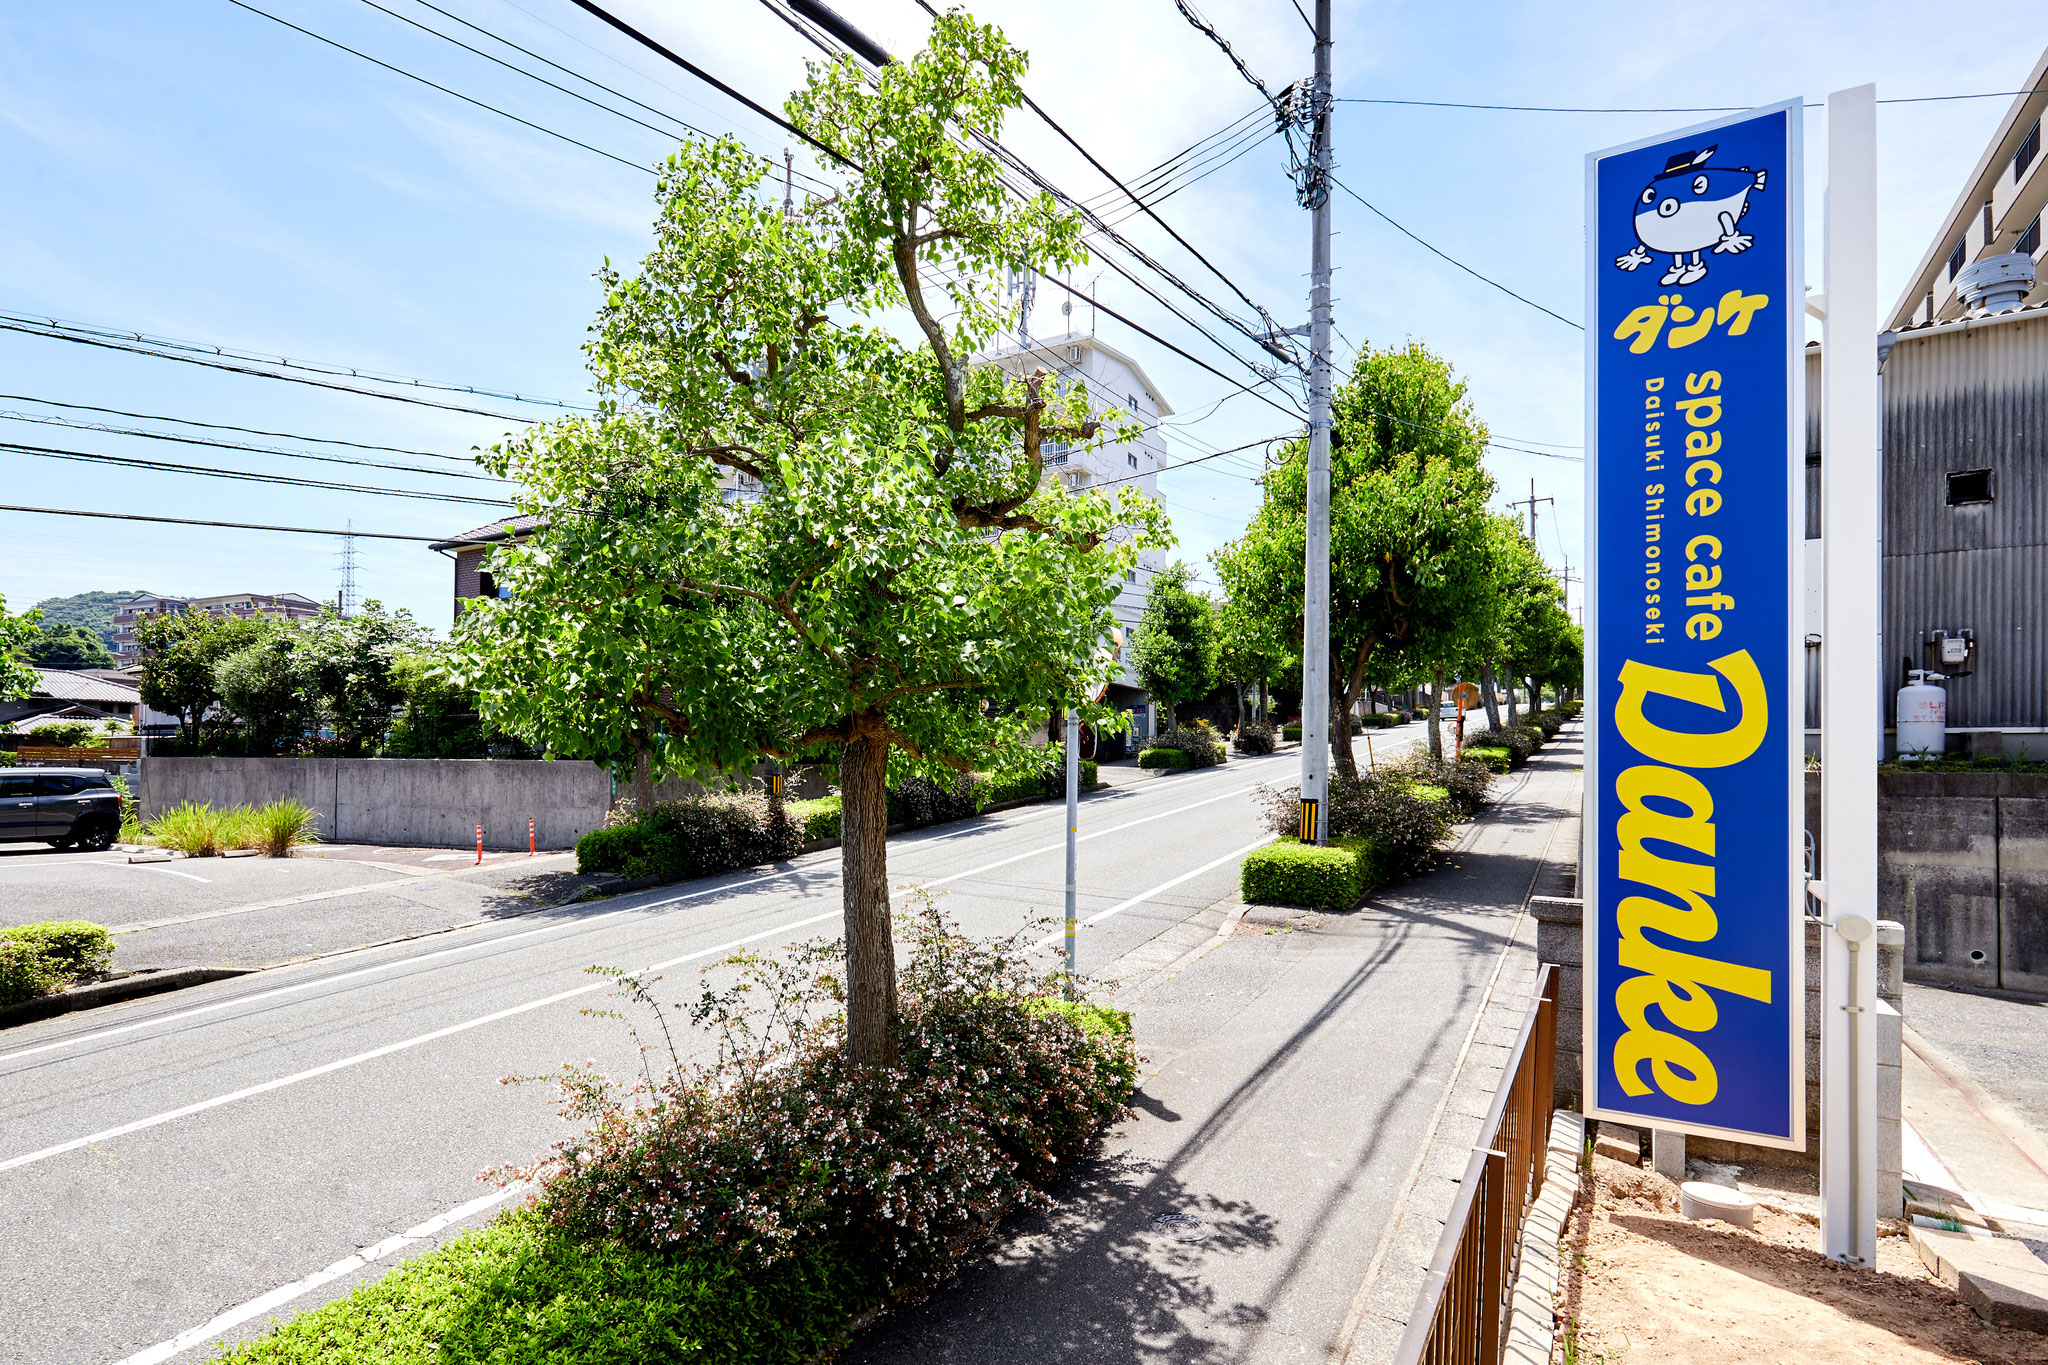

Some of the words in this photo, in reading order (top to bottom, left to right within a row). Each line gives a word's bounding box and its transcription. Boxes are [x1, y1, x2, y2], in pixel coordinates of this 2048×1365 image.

[1613, 289, 1769, 354] ダンケ
[1645, 377, 1665, 471] Daisuki
[1675, 370, 1722, 517] space
[1645, 483, 1665, 644] Shimonoseki
[1685, 534, 1735, 641] cafe
[1613, 648, 1772, 1106] Danke
